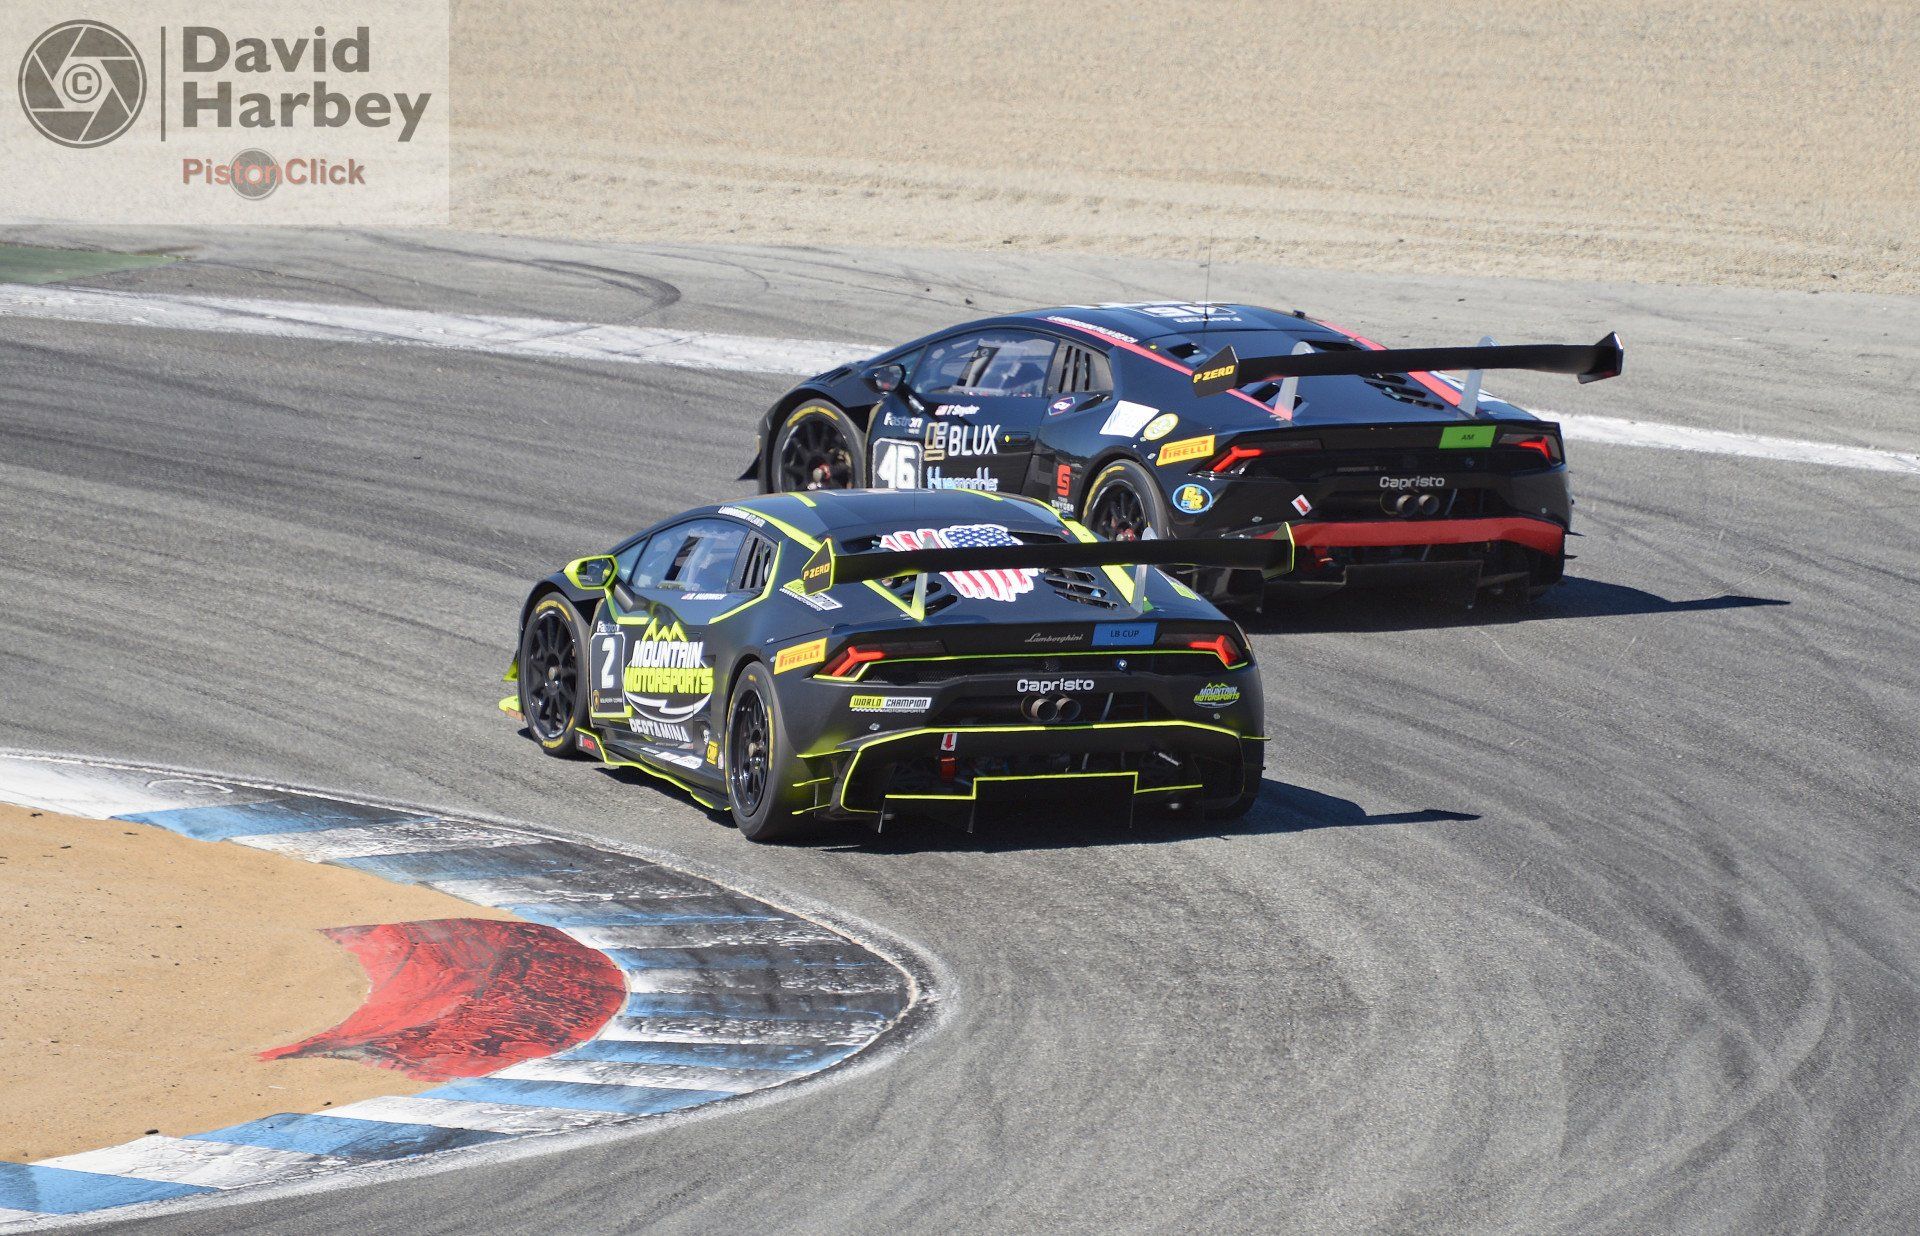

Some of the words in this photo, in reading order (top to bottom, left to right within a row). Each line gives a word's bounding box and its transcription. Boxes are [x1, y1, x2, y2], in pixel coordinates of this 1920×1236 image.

[1202, 365, 1235, 381] ZERO
[948, 424, 1000, 456] BLUX
[1162, 440, 1208, 459] PIRELLI
[877, 443, 916, 489] 46
[1379, 476, 1445, 490] Capristo
[810, 563, 830, 578] ZERO
[1025, 633, 1083, 643] Lamborghini
[1110, 630, 1121, 638] LB
[1122, 630, 1140, 638] CUP
[602, 637, 615, 689] 2
[631, 641, 703, 668] MOUNTAIN
[779, 645, 820, 667] PIRELLI
[624, 667, 713, 694] MOTORSPORTS
[1017, 678, 1094, 694] Capristo
[853, 698, 882, 707] WORLD
[886, 699, 928, 708] CHAMPION
